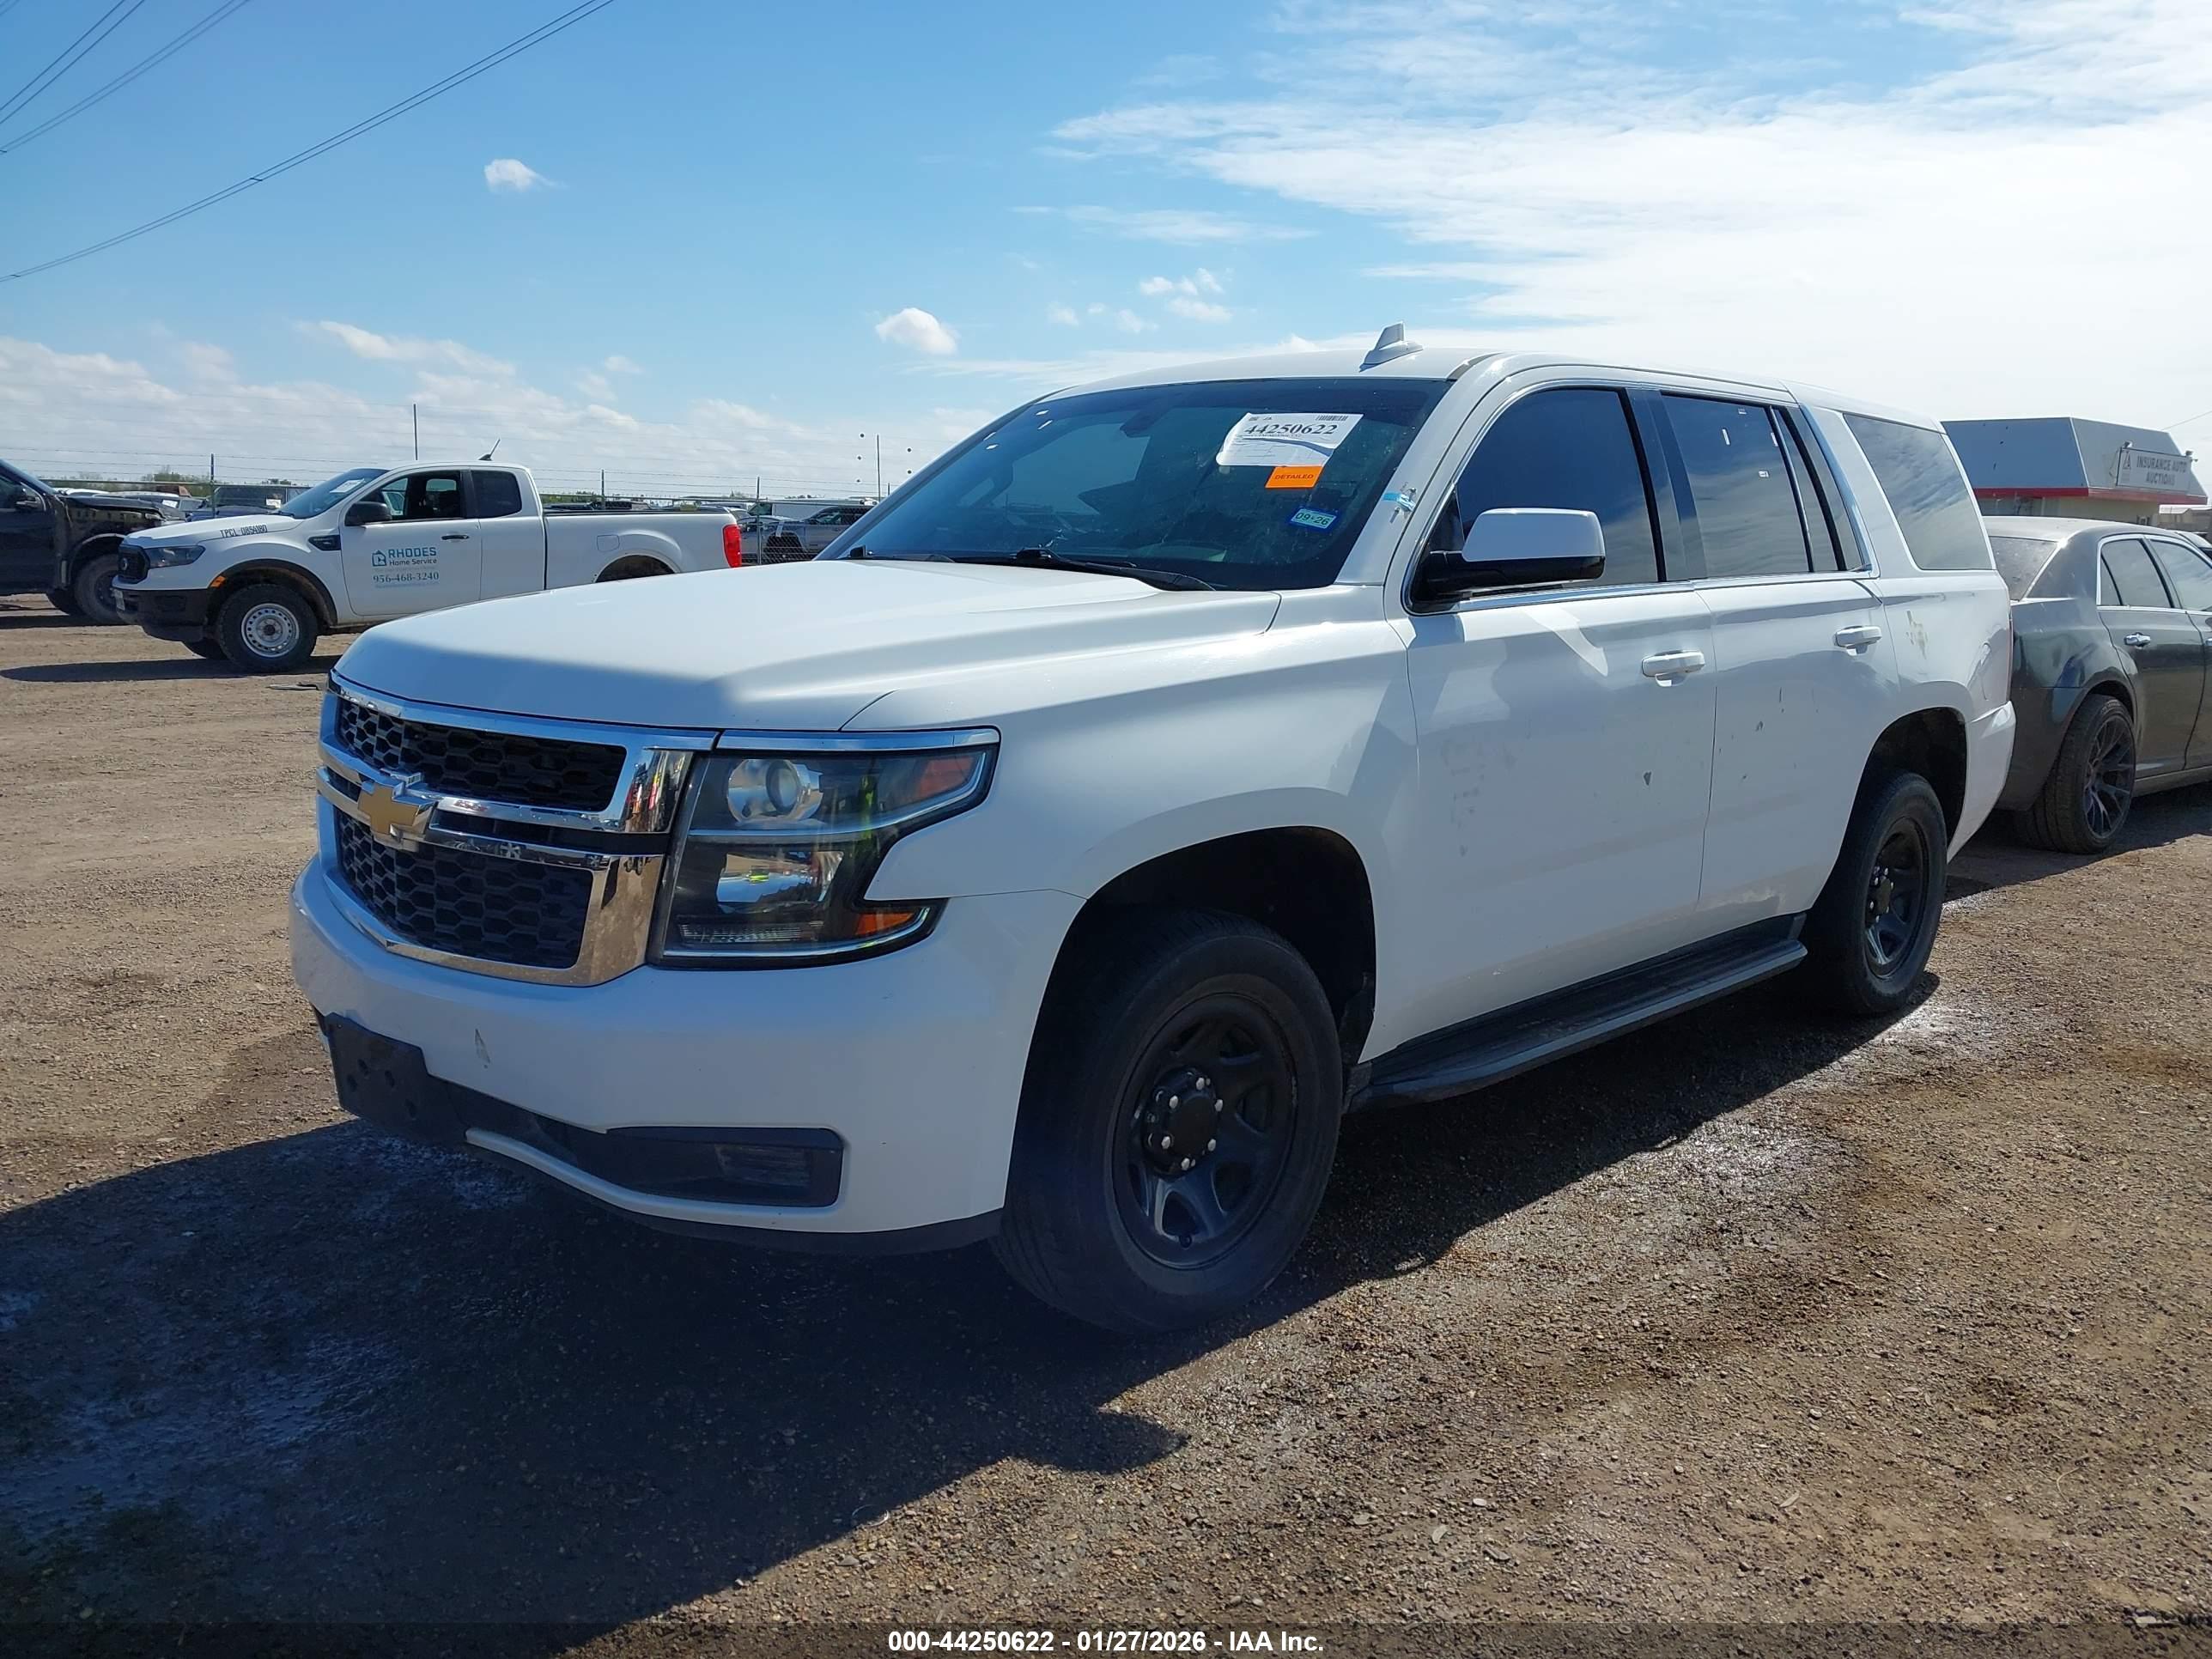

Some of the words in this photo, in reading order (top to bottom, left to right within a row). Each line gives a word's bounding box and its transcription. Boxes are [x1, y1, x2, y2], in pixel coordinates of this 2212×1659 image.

[1244, 423, 1339, 435] 44250622
[2136, 455, 2172, 471] INSURANCE
[2172, 460, 2188, 473] AUTO
[2146, 471, 2176, 486] AUCTIONS
[388, 547, 437, 558] RHODES
[373, 572, 439, 583] 956-468-3240
